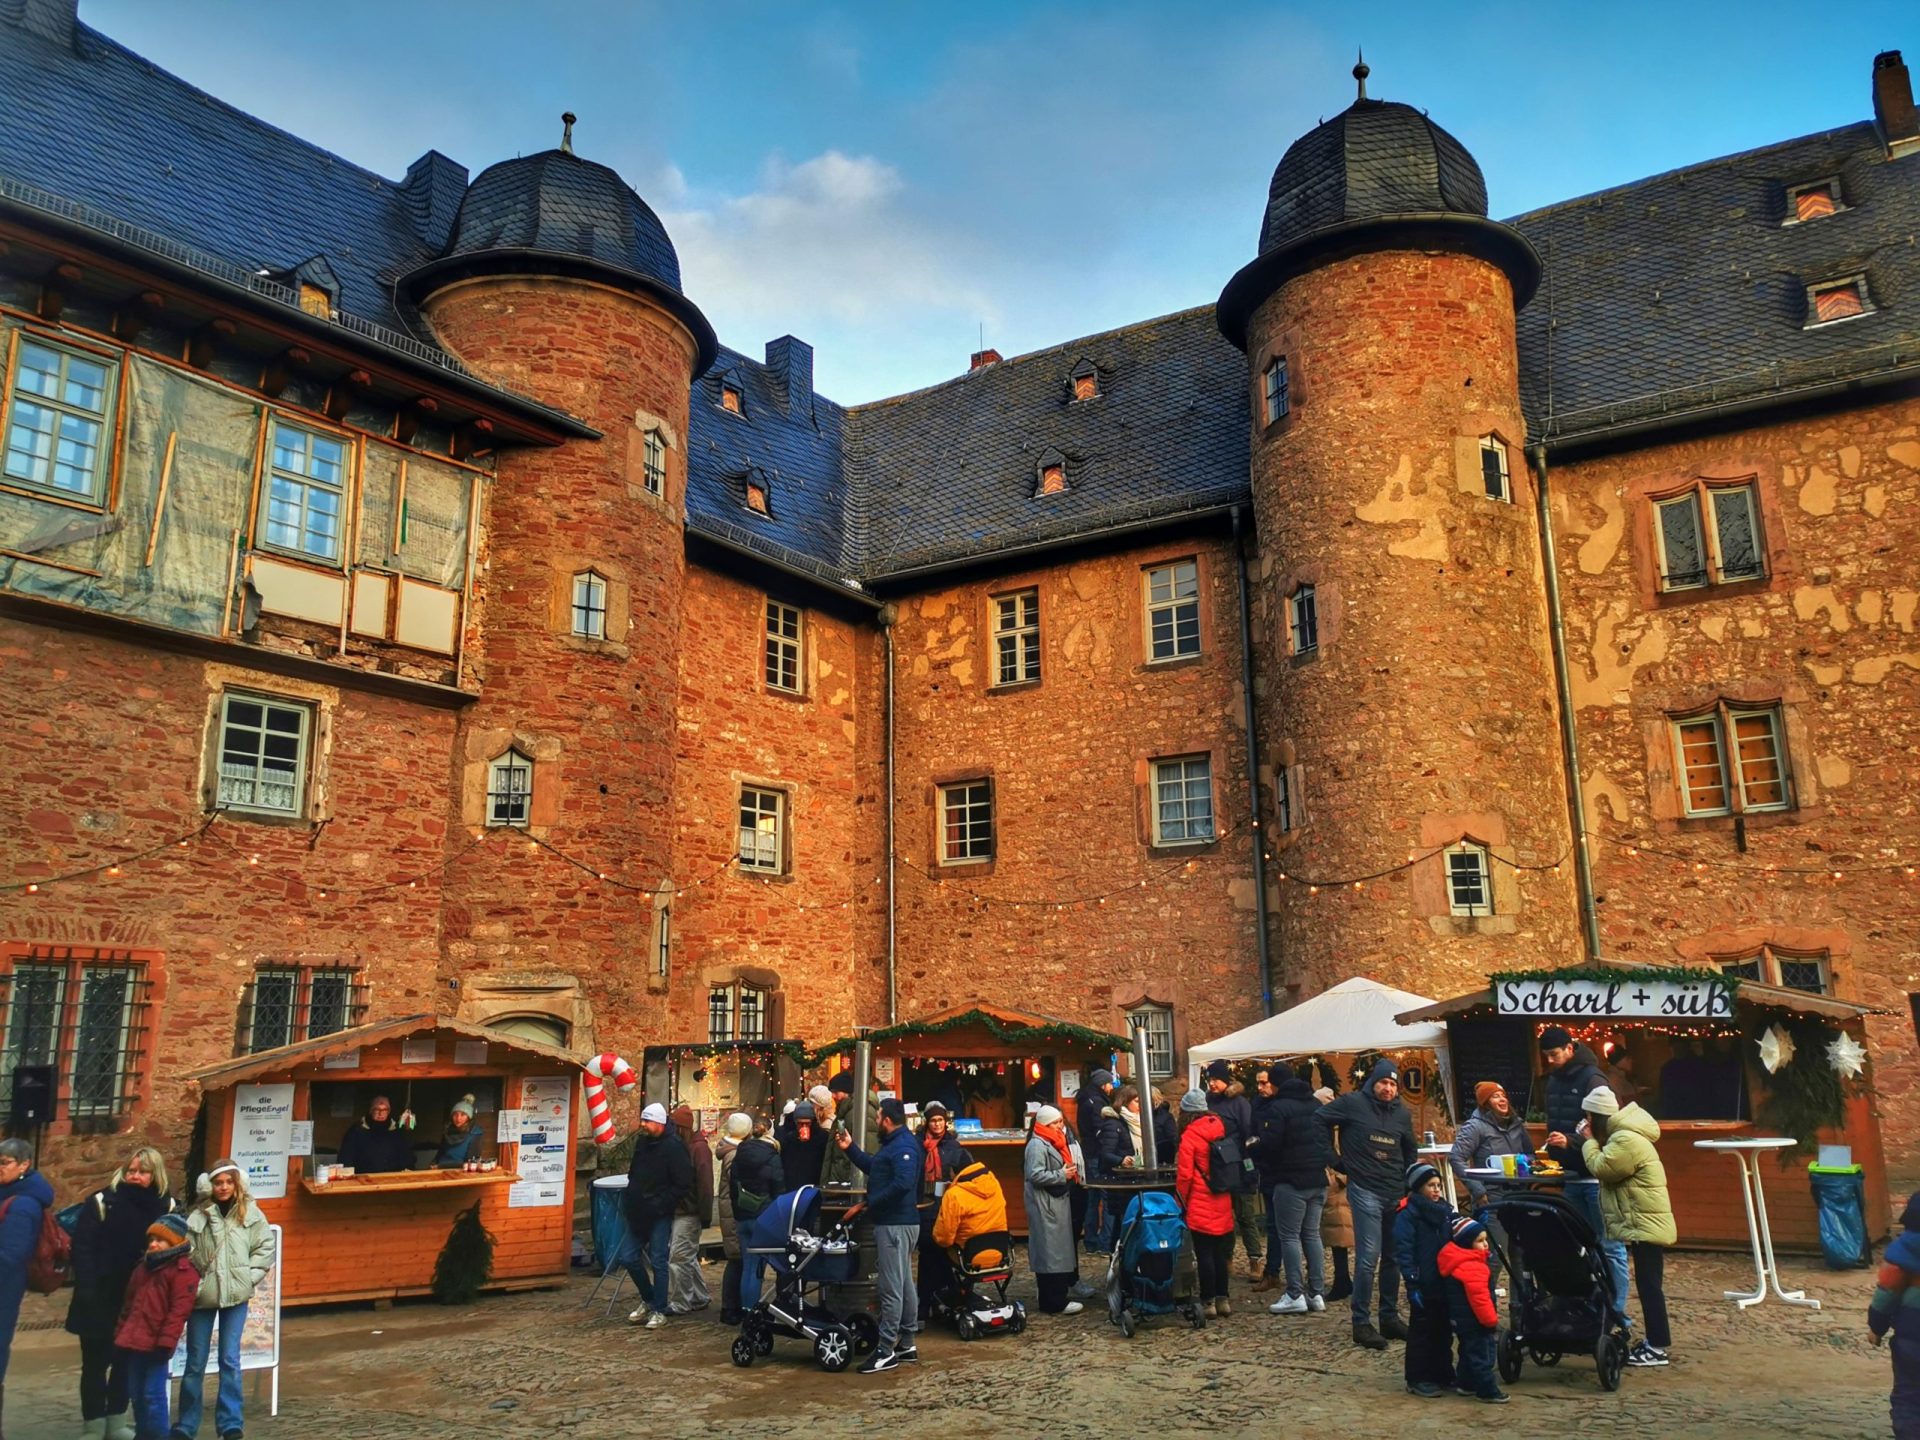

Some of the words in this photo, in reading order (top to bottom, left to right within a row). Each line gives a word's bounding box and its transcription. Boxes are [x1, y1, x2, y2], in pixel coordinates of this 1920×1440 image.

[1632, 988, 1651, 1006] +
[1661, 980, 1728, 1016] süß
[1402, 1060, 1421, 1068] LION
[258, 1096, 272, 1104] die
[240, 1104, 289, 1113] PflegeEngel
